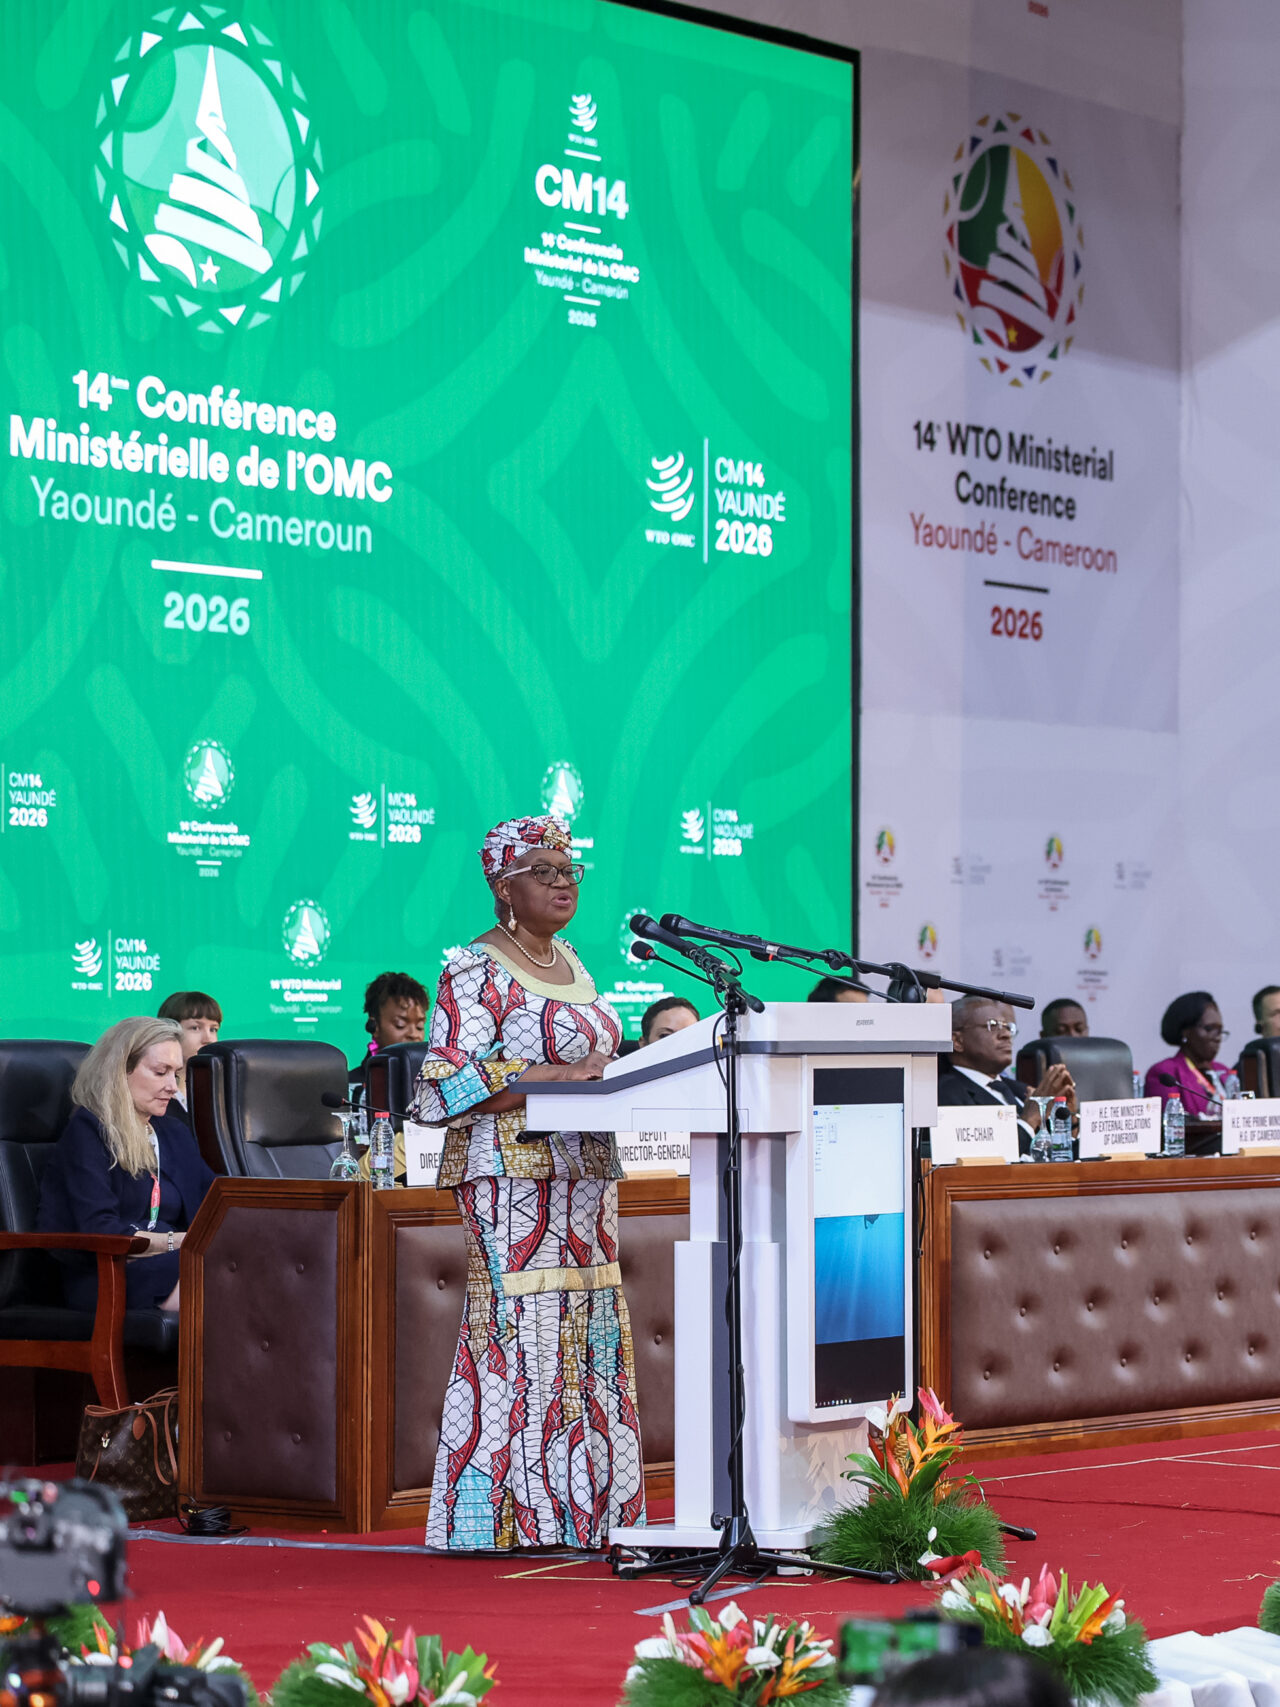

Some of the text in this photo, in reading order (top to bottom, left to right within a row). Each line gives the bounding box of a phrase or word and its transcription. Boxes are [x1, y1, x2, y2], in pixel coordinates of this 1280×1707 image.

[535, 163, 629, 220] CM14
[136, 376, 337, 442] Conférence
[10, 414, 230, 483] Ministérielle
[236, 445, 280, 490] de
[947, 421, 1001, 461] WTO
[1008, 431, 1114, 482] Ministerial
[715, 456, 765, 488] CM14
[714, 488, 786, 522] YAUNDÉ
[955, 470, 1076, 521] Conference
[30, 475, 177, 532] Yaoundé
[208, 497, 373, 553] Cameroun
[715, 518, 773, 557] 2026
[909, 511, 997, 556] Yaoundé
[1017, 525, 1117, 574] Cameroon
[163, 591, 250, 636] 2026
[991, 605, 1043, 641] 2026
[9, 772, 43, 788] CM14
[9, 788, 56, 807] YAUNDÉ
[388, 792, 417, 808] MC14
[9, 807, 48, 827] 2026
[388, 807, 435, 825] YAOUNDÉ
[388, 823, 421, 843] 2026
[115, 937, 147, 953] CM14
[114, 953, 160, 971] YAUNDÉ
[115, 972, 152, 991] 2026
[1110, 1106, 1119, 1118] THE
[1120, 1104, 1144, 1117] MINISTER
[956, 1127, 994, 1142] VICE-CHAIR
[1091, 1118, 1151, 1133] OF EXTERNAL RELATIONS
[639, 1131, 667, 1142] DEPUTY
[1104, 1132, 1138, 1145] OF CAMEROON
